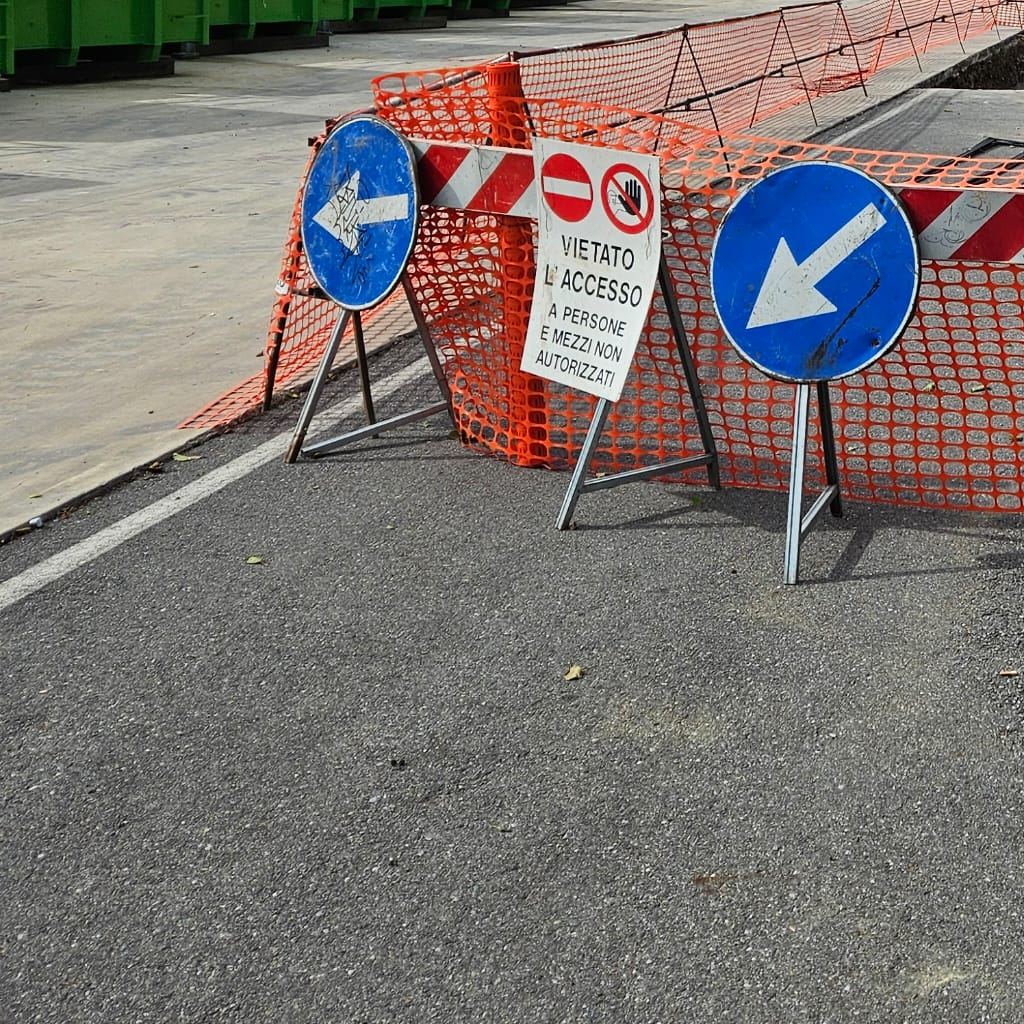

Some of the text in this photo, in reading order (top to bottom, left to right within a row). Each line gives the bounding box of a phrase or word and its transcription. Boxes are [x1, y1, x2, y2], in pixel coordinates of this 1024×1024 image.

[561, 234, 635, 270] VIETATO
[548, 303, 627, 337] A PERSONE
[540, 325, 622, 363] E MEZZI NON
[535, 349, 615, 387] AUTORIZZATI
